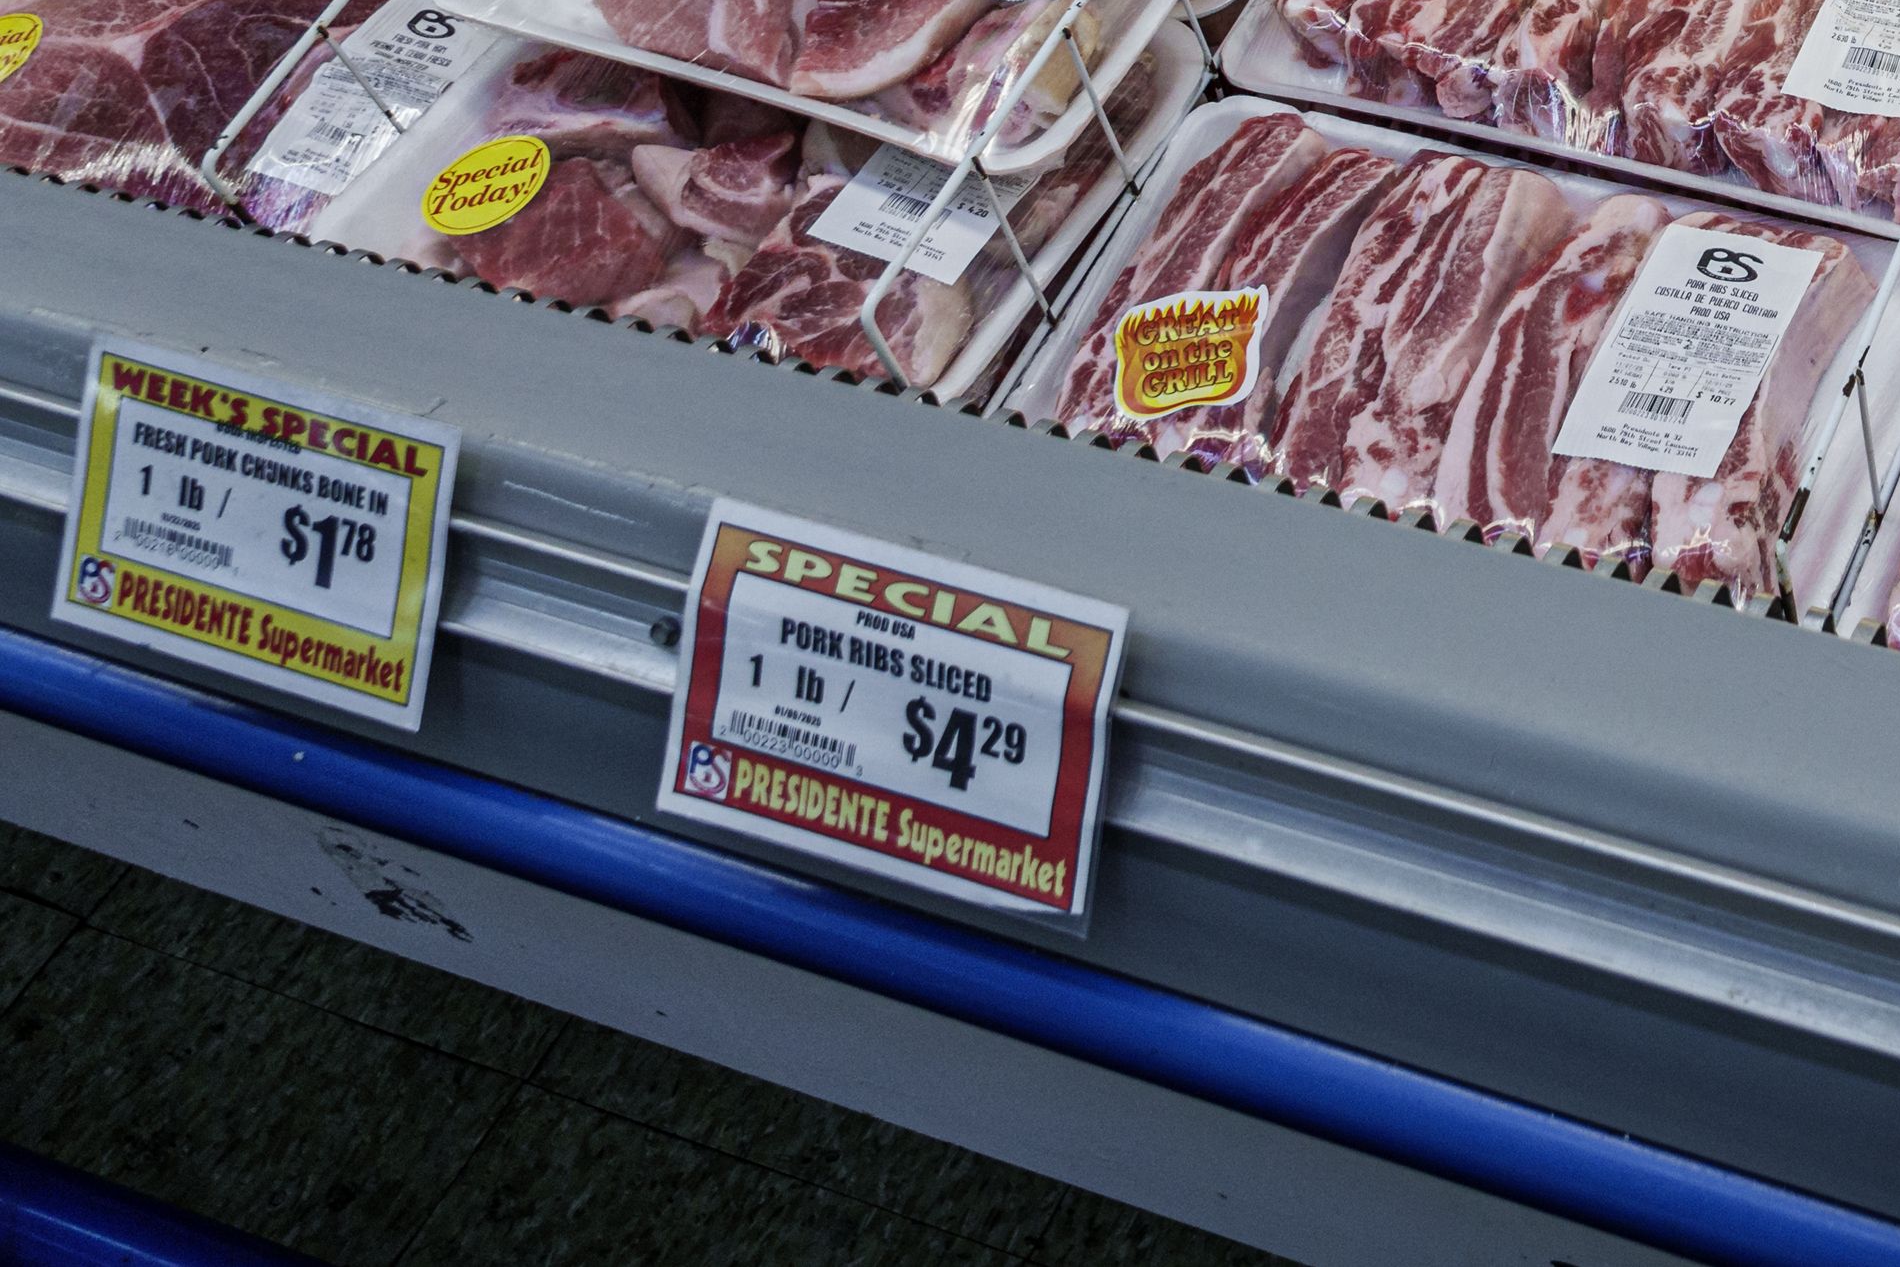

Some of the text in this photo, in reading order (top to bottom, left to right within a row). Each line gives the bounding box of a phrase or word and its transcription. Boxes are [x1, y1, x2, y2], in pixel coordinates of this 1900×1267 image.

[432, 148, 543, 186] Special
[429, 178, 537, 216] Today!
[1655, 285, 1779, 319] COSTILLA DE PUERCO CORTADA
[1685, 278, 1760, 302] PORK RIBS SLICED
[1138, 308, 1241, 345] GREAT
[1690, 305, 1731, 322] PROD USA
[1143, 337, 1233, 372] on the
[1141, 361, 1234, 398] GRILL
[112, 362, 428, 477] WEEK'S SPECIAL
[134, 422, 187, 457] FRESH
[191, 440, 238, 472] PORK
[241, 457, 313, 493] CHUNKS
[317, 475, 365, 508] BONE
[369, 491, 388, 515] IN
[140, 465, 154, 496] 1
[179, 475, 205, 511] lb
[746, 540, 1073, 659] SPECIAL
[118, 570, 406, 694] PRESIDENTE Supermarket
[857, 610, 916, 641] PROD USA
[749, 653, 764, 687] 1
[796, 666, 825, 704] lb
[781, 617, 992, 703] PORK RIBS SLICED
[733, 759, 1067, 897] PRESIDENTE Supermarket
